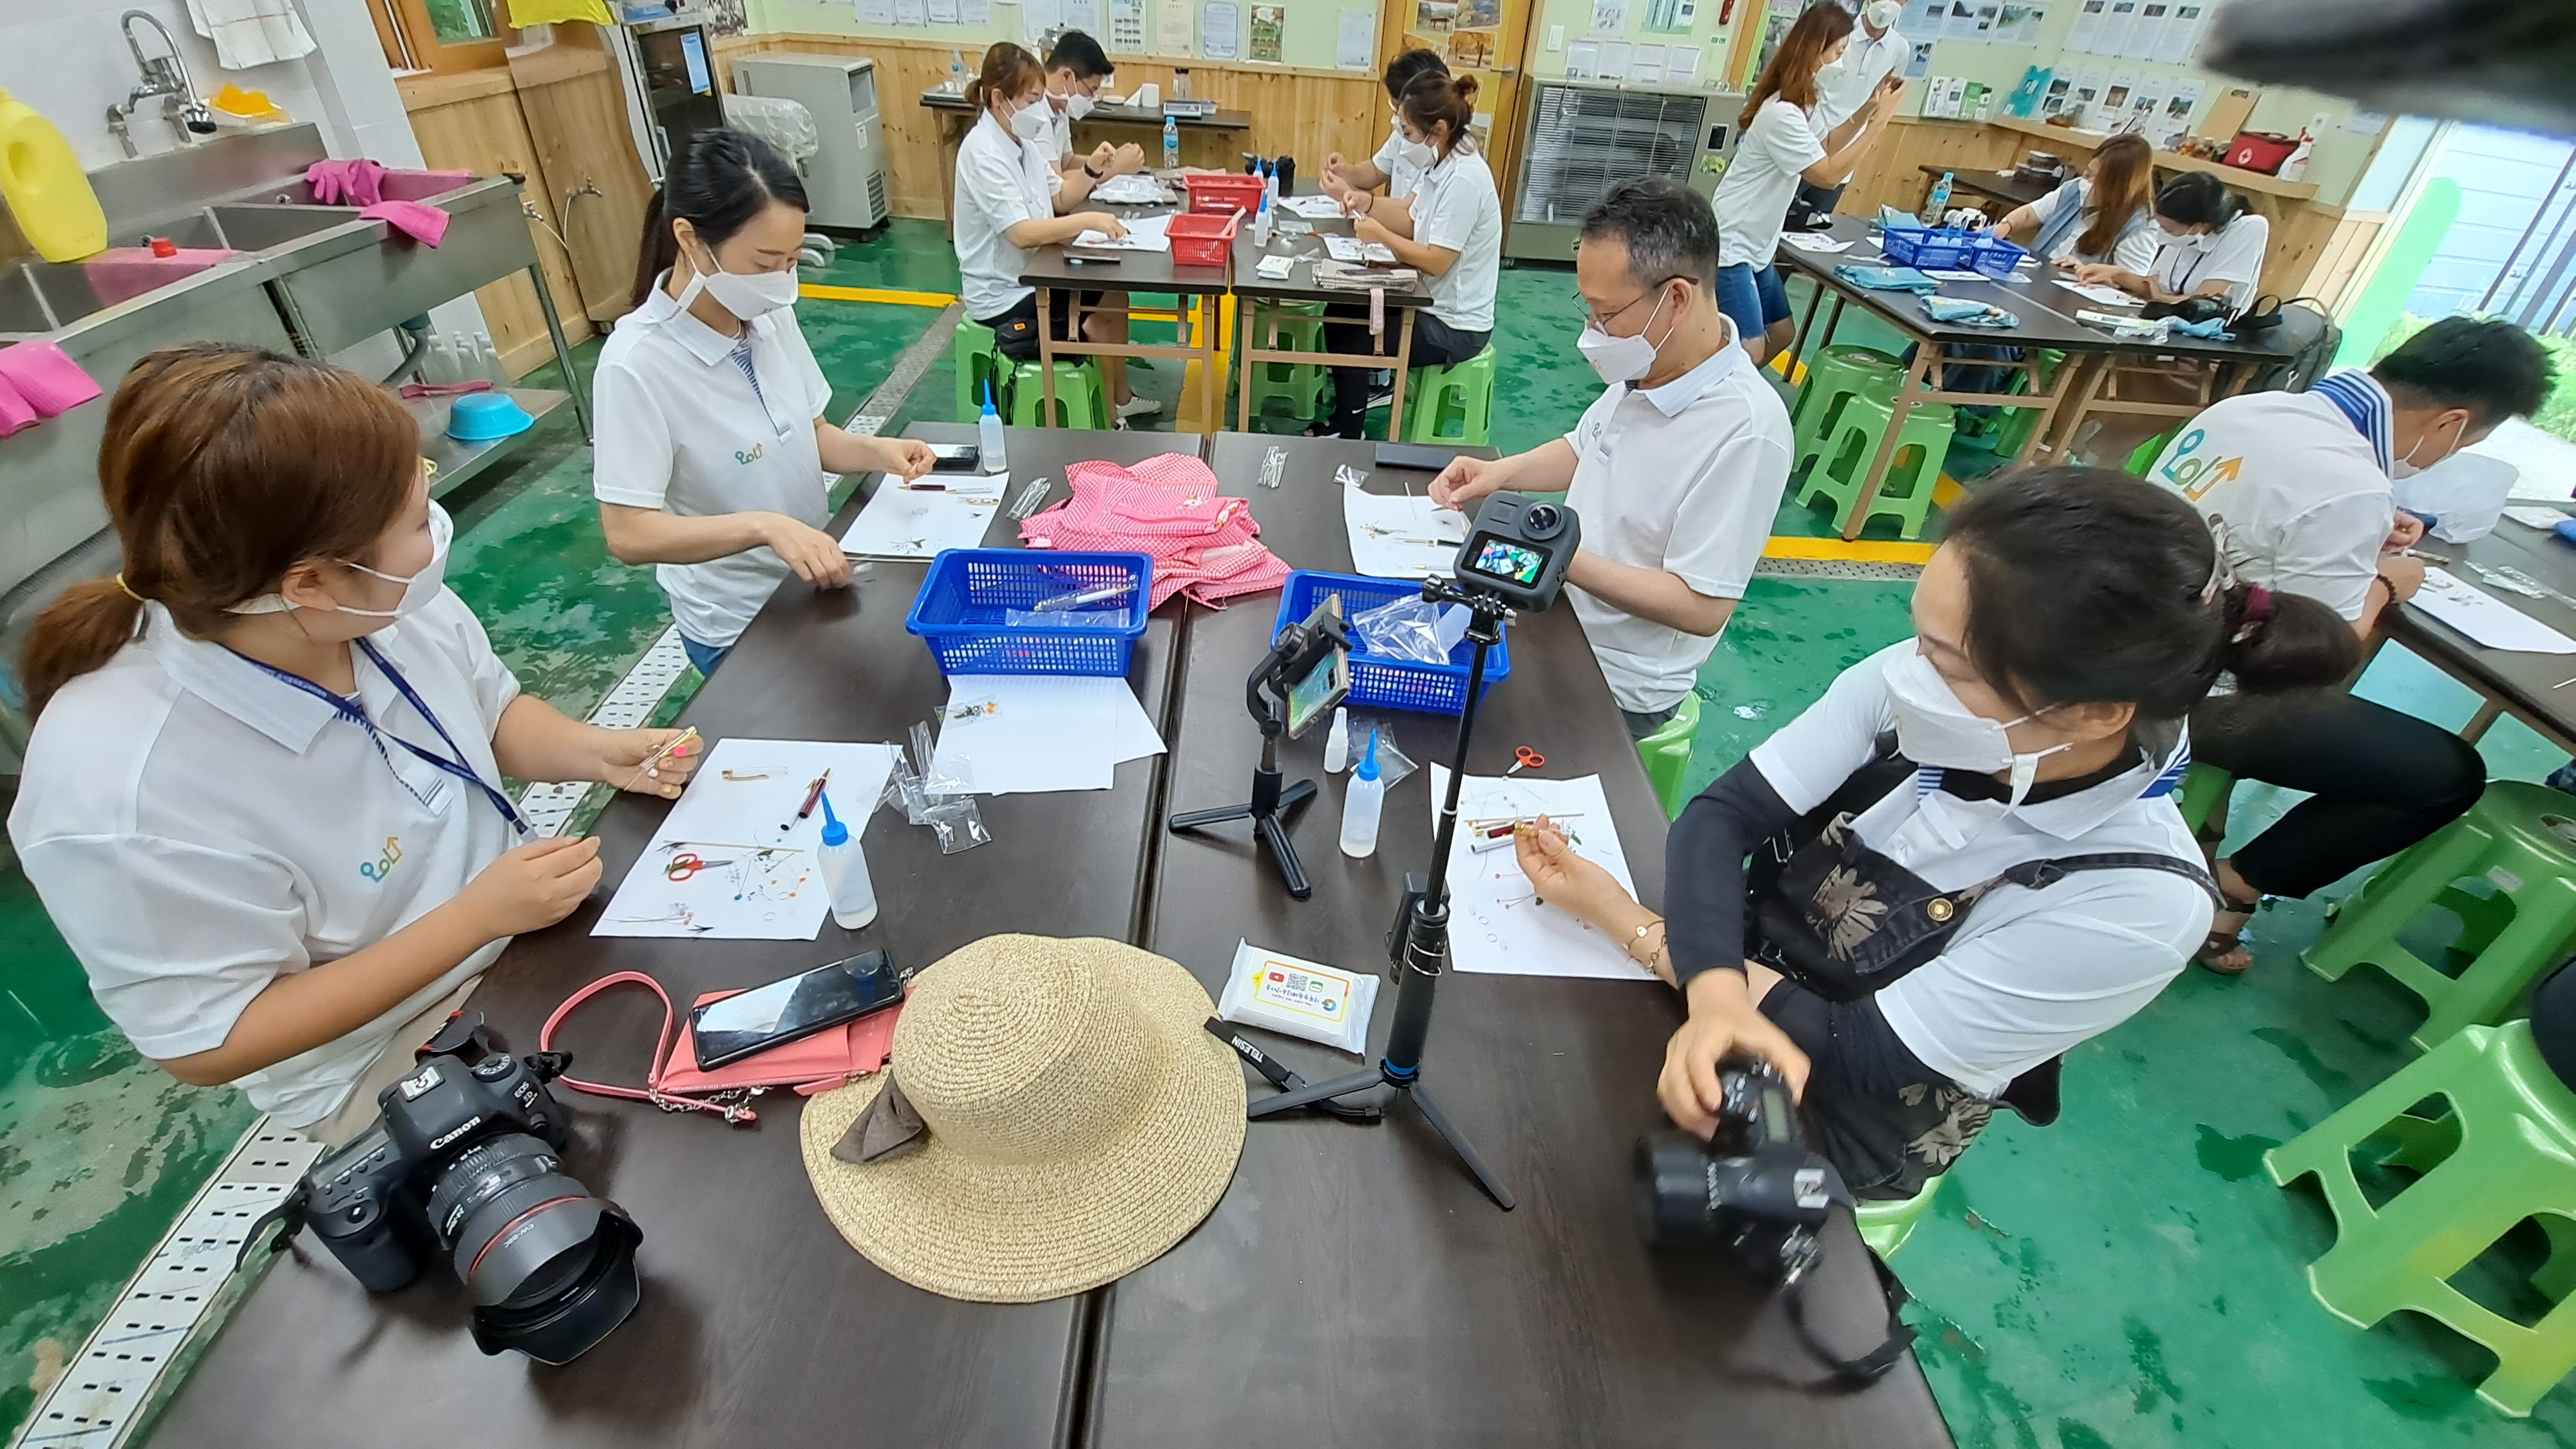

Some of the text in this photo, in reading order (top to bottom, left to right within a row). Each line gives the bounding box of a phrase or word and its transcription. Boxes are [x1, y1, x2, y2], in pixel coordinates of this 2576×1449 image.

[1231, 1036, 1264, 1063] TELESIN
[515, 1081, 530, 1098] EOS
[430, 1116, 482, 1150] Canon
